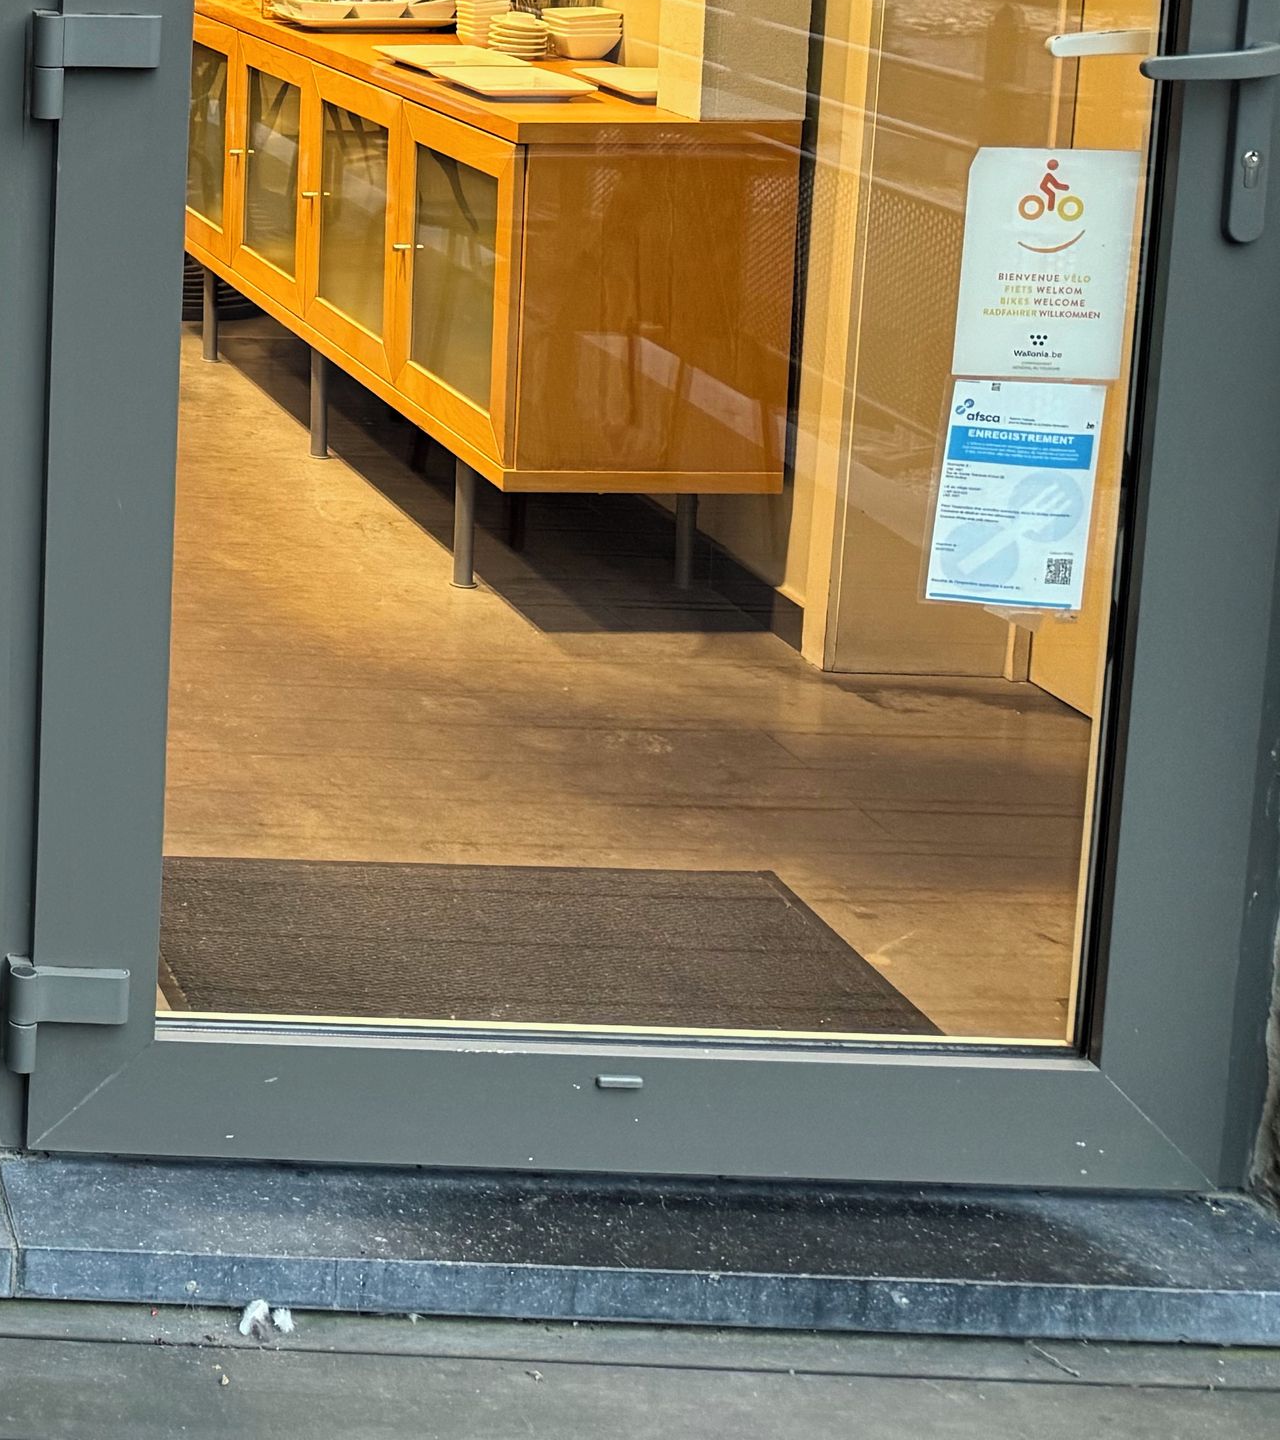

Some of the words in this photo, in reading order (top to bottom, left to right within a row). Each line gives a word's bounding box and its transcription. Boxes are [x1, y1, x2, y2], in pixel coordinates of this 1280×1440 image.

[998, 273, 1060, 282] BIENVENUE
[1064, 273, 1092, 283] VÉLO
[1005, 285, 1032, 294] FIETS
[1037, 286, 1083, 295] WELKOM
[1000, 297, 1029, 305] BIKES
[1034, 298, 1086, 307] WELCOME
[983, 308, 1037, 317] RADFAHRER
[1039, 310, 1101, 319] WILLKOMMEN
[967, 411, 1000, 423] afsca
[968, 428, 1075, 445] ENREGISTREMENT
